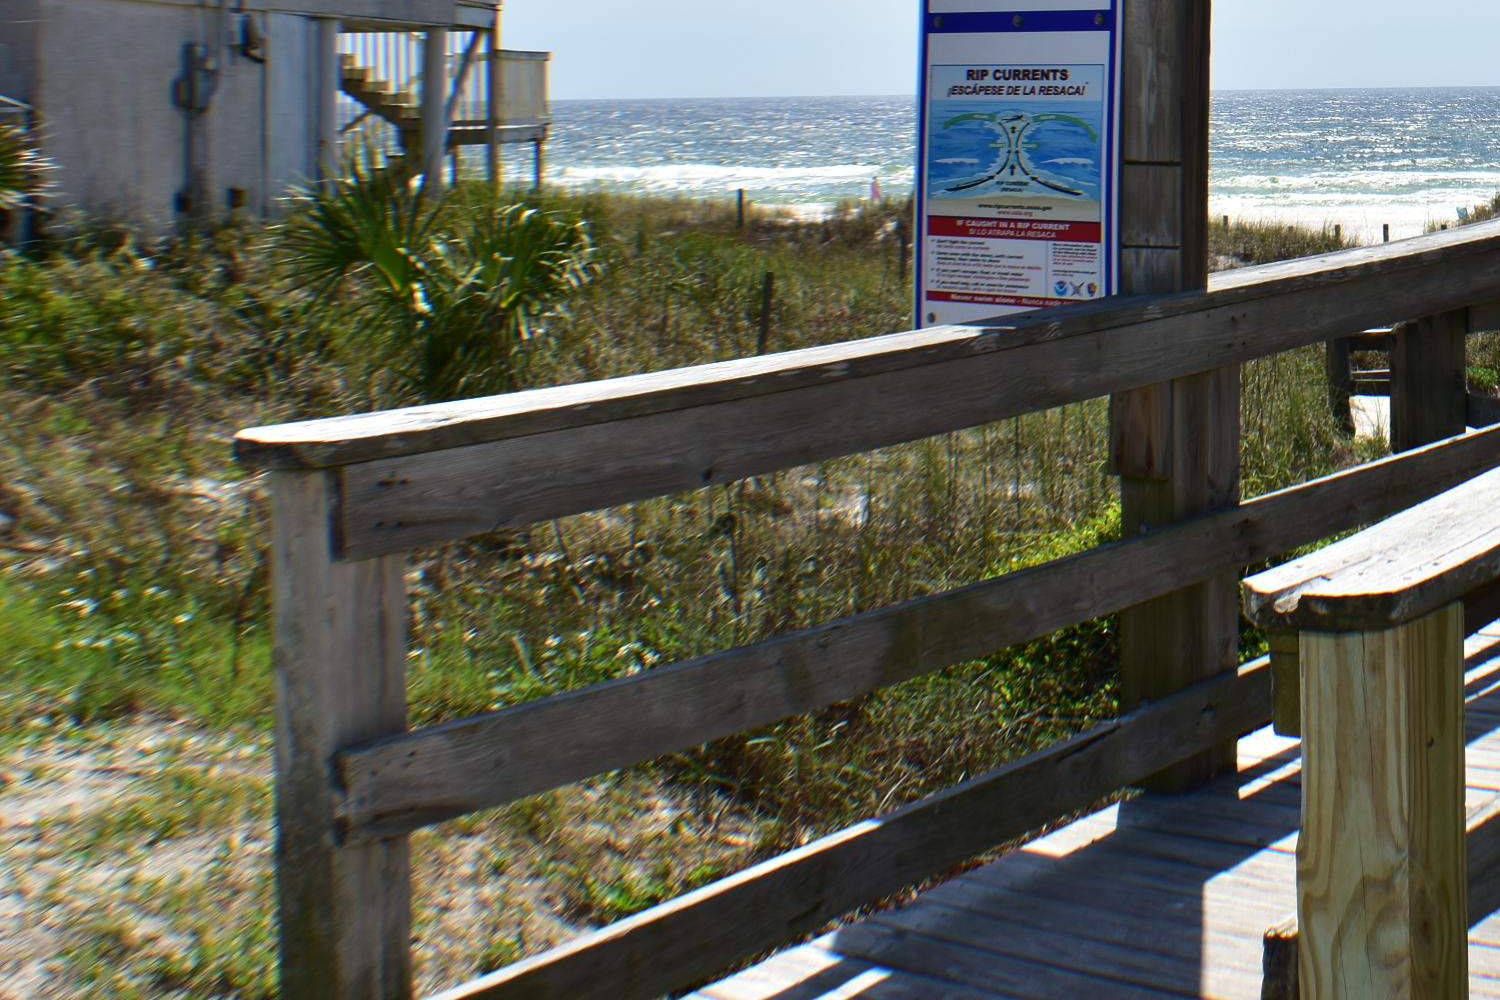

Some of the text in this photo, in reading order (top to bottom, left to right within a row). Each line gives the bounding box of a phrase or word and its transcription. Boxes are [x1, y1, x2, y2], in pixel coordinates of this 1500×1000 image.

[966, 69, 1068, 80] RIP CURRENTS
[1007, 84, 1020, 96] DE
[1023, 85, 1036, 96] LA
